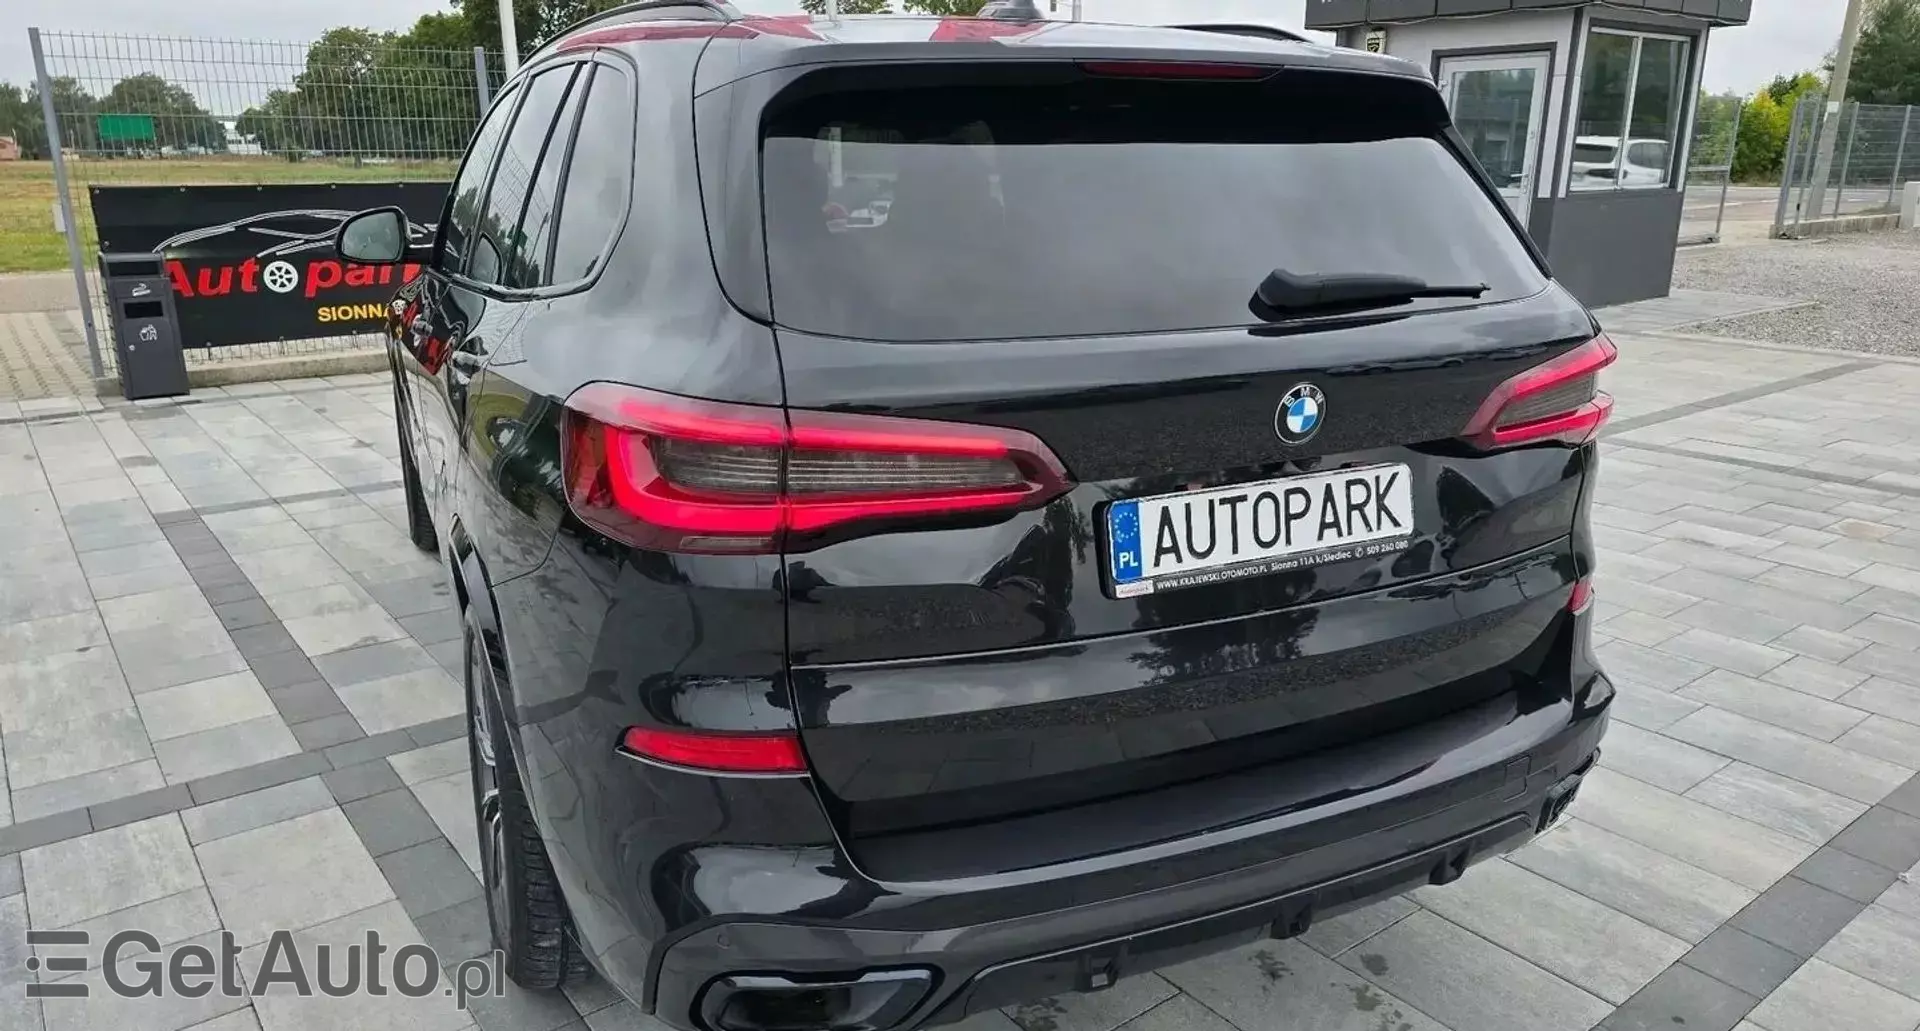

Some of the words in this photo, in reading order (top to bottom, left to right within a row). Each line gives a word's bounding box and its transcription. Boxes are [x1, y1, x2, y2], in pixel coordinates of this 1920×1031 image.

[317, 303, 389, 323] SIONN
[1152, 471, 1402, 568] AUTOPARK
[1118, 551, 1139, 569] PL
[1271, 560, 1298, 572] Sionna
